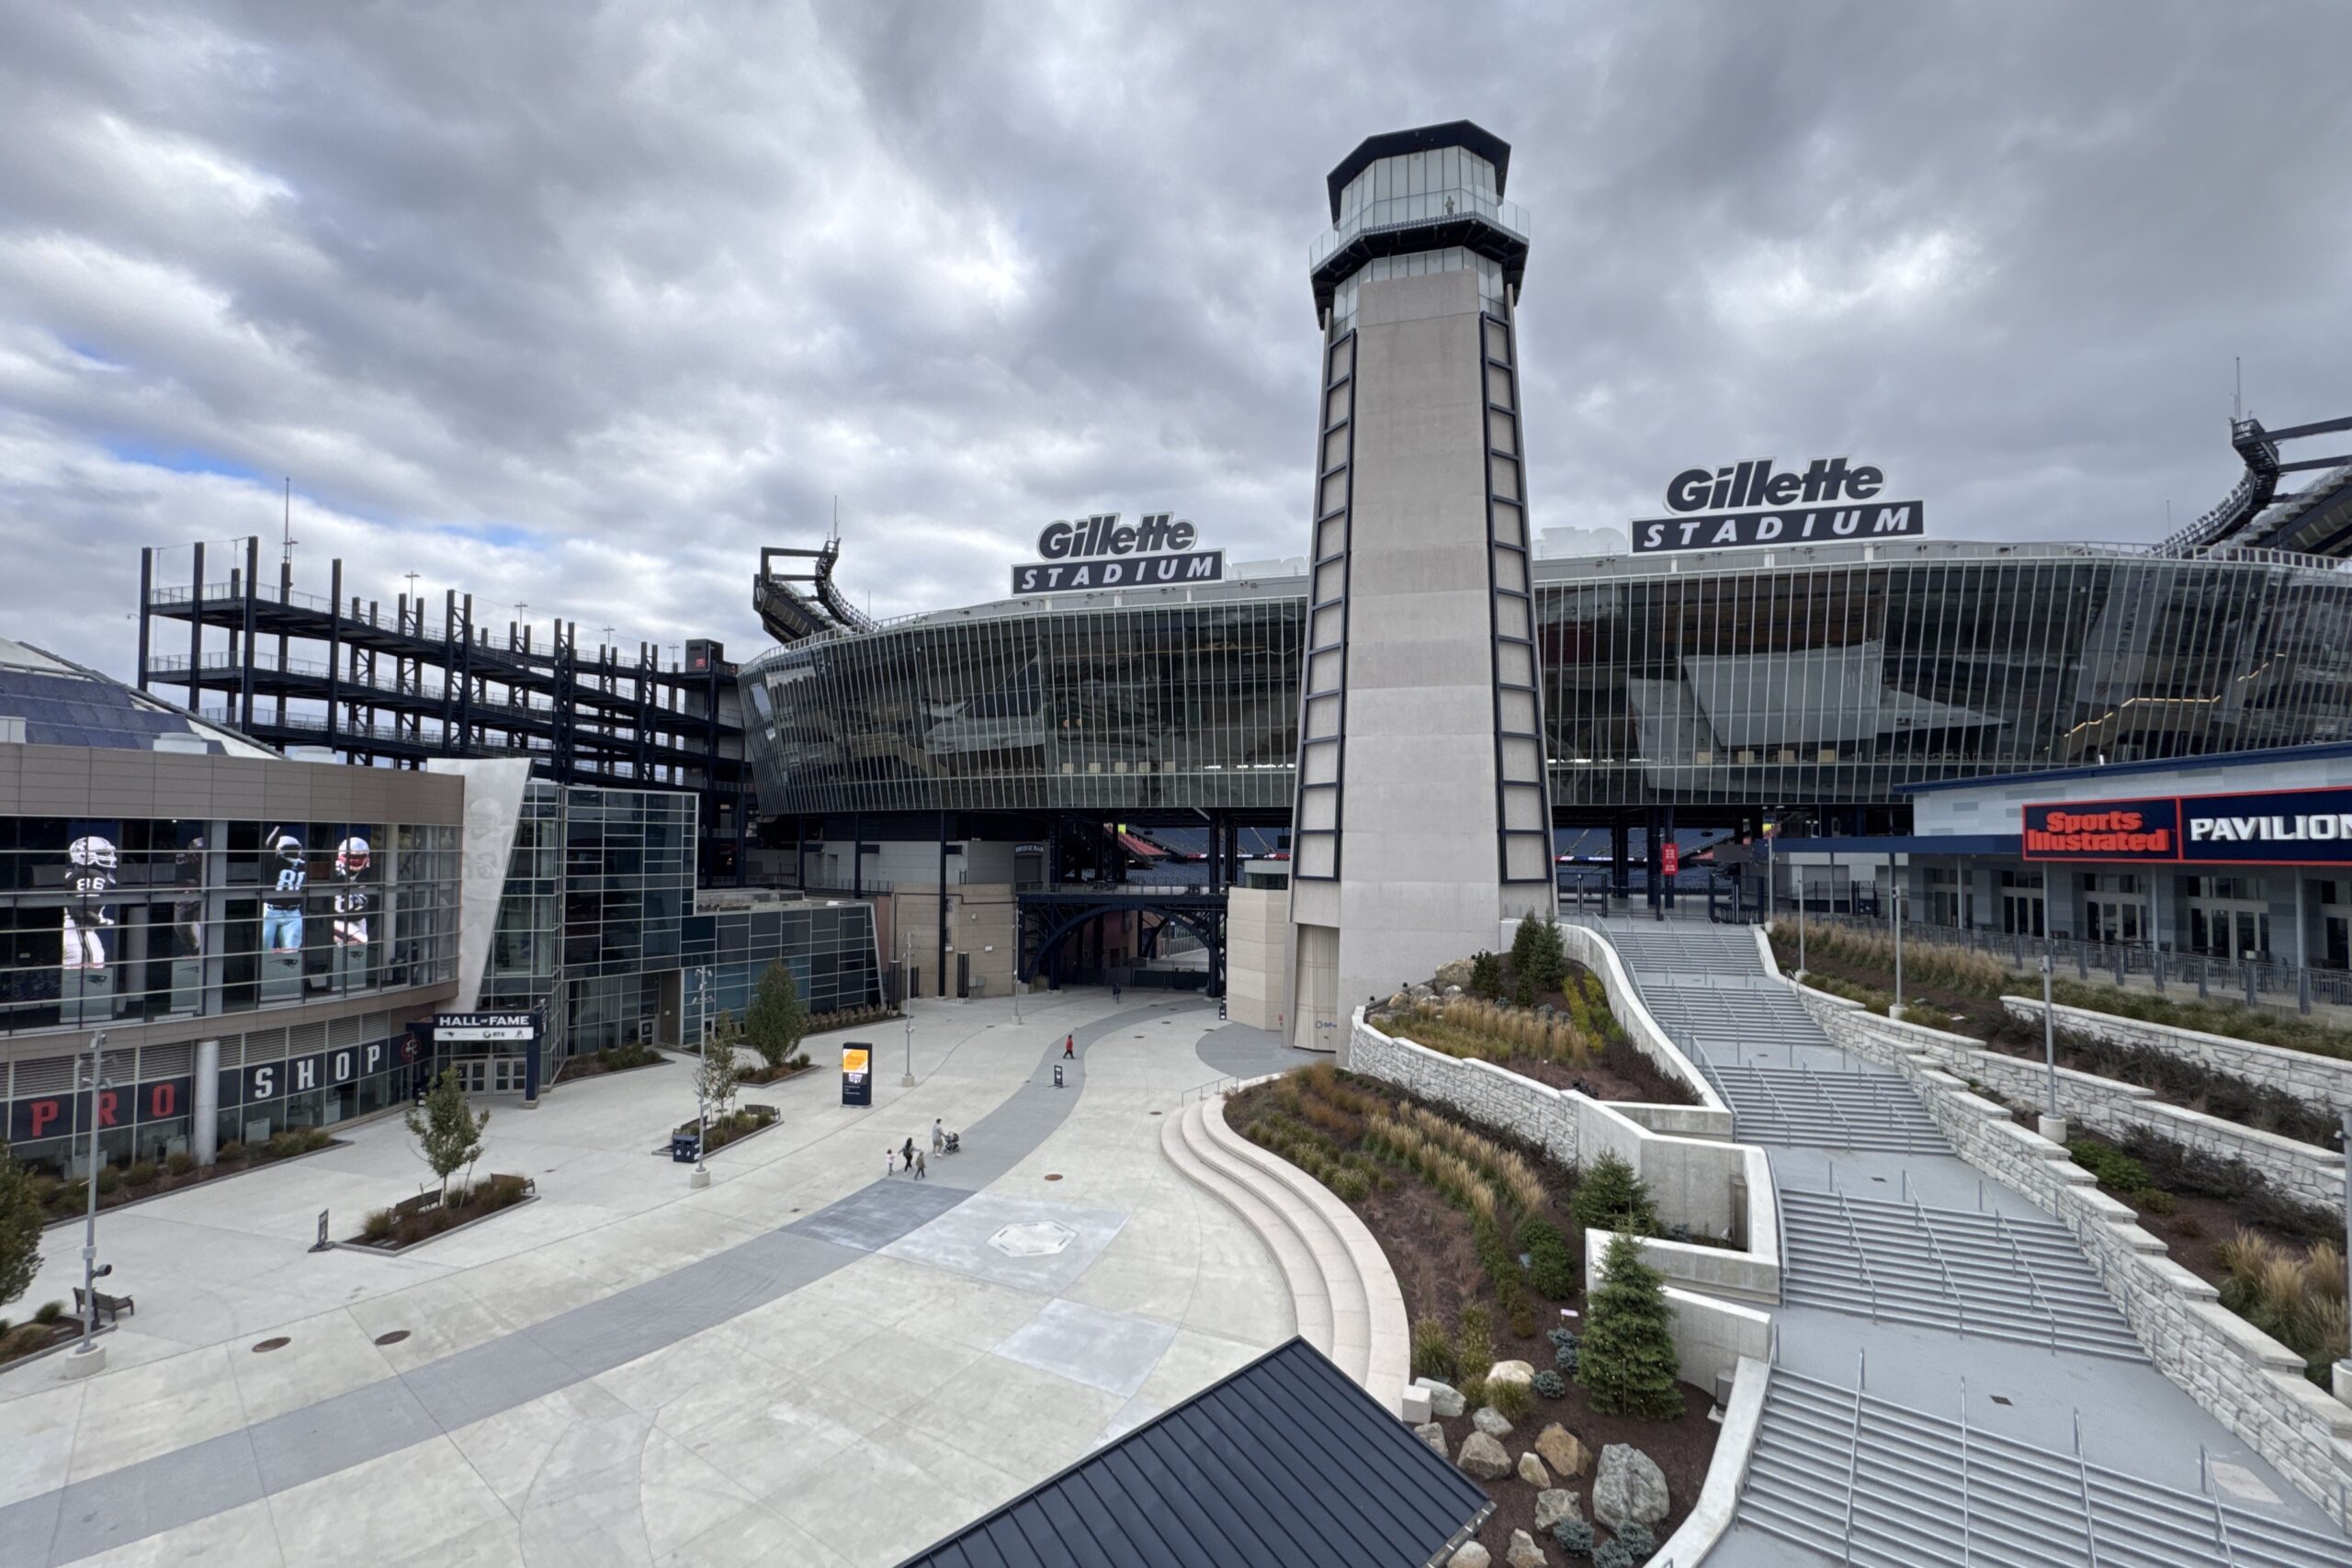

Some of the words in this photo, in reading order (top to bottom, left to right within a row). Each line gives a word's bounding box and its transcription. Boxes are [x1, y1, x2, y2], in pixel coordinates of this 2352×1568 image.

[1667, 457, 1883, 512] Gillette
[1039, 514, 1194, 558] Gillette
[1644, 507, 1910, 547] STADIUM
[1022, 557, 1213, 590] STADIUM
[2046, 811, 2143, 833] Sports
[2028, 829, 2169, 852] Illustrated
[76, 877, 106, 891] 86
[439, 1016, 481, 1026] HALL
[489, 1015, 529, 1025] FAME
[29, 1083, 175, 1137] PRO
[254, 1044, 380, 1099] SHOP
